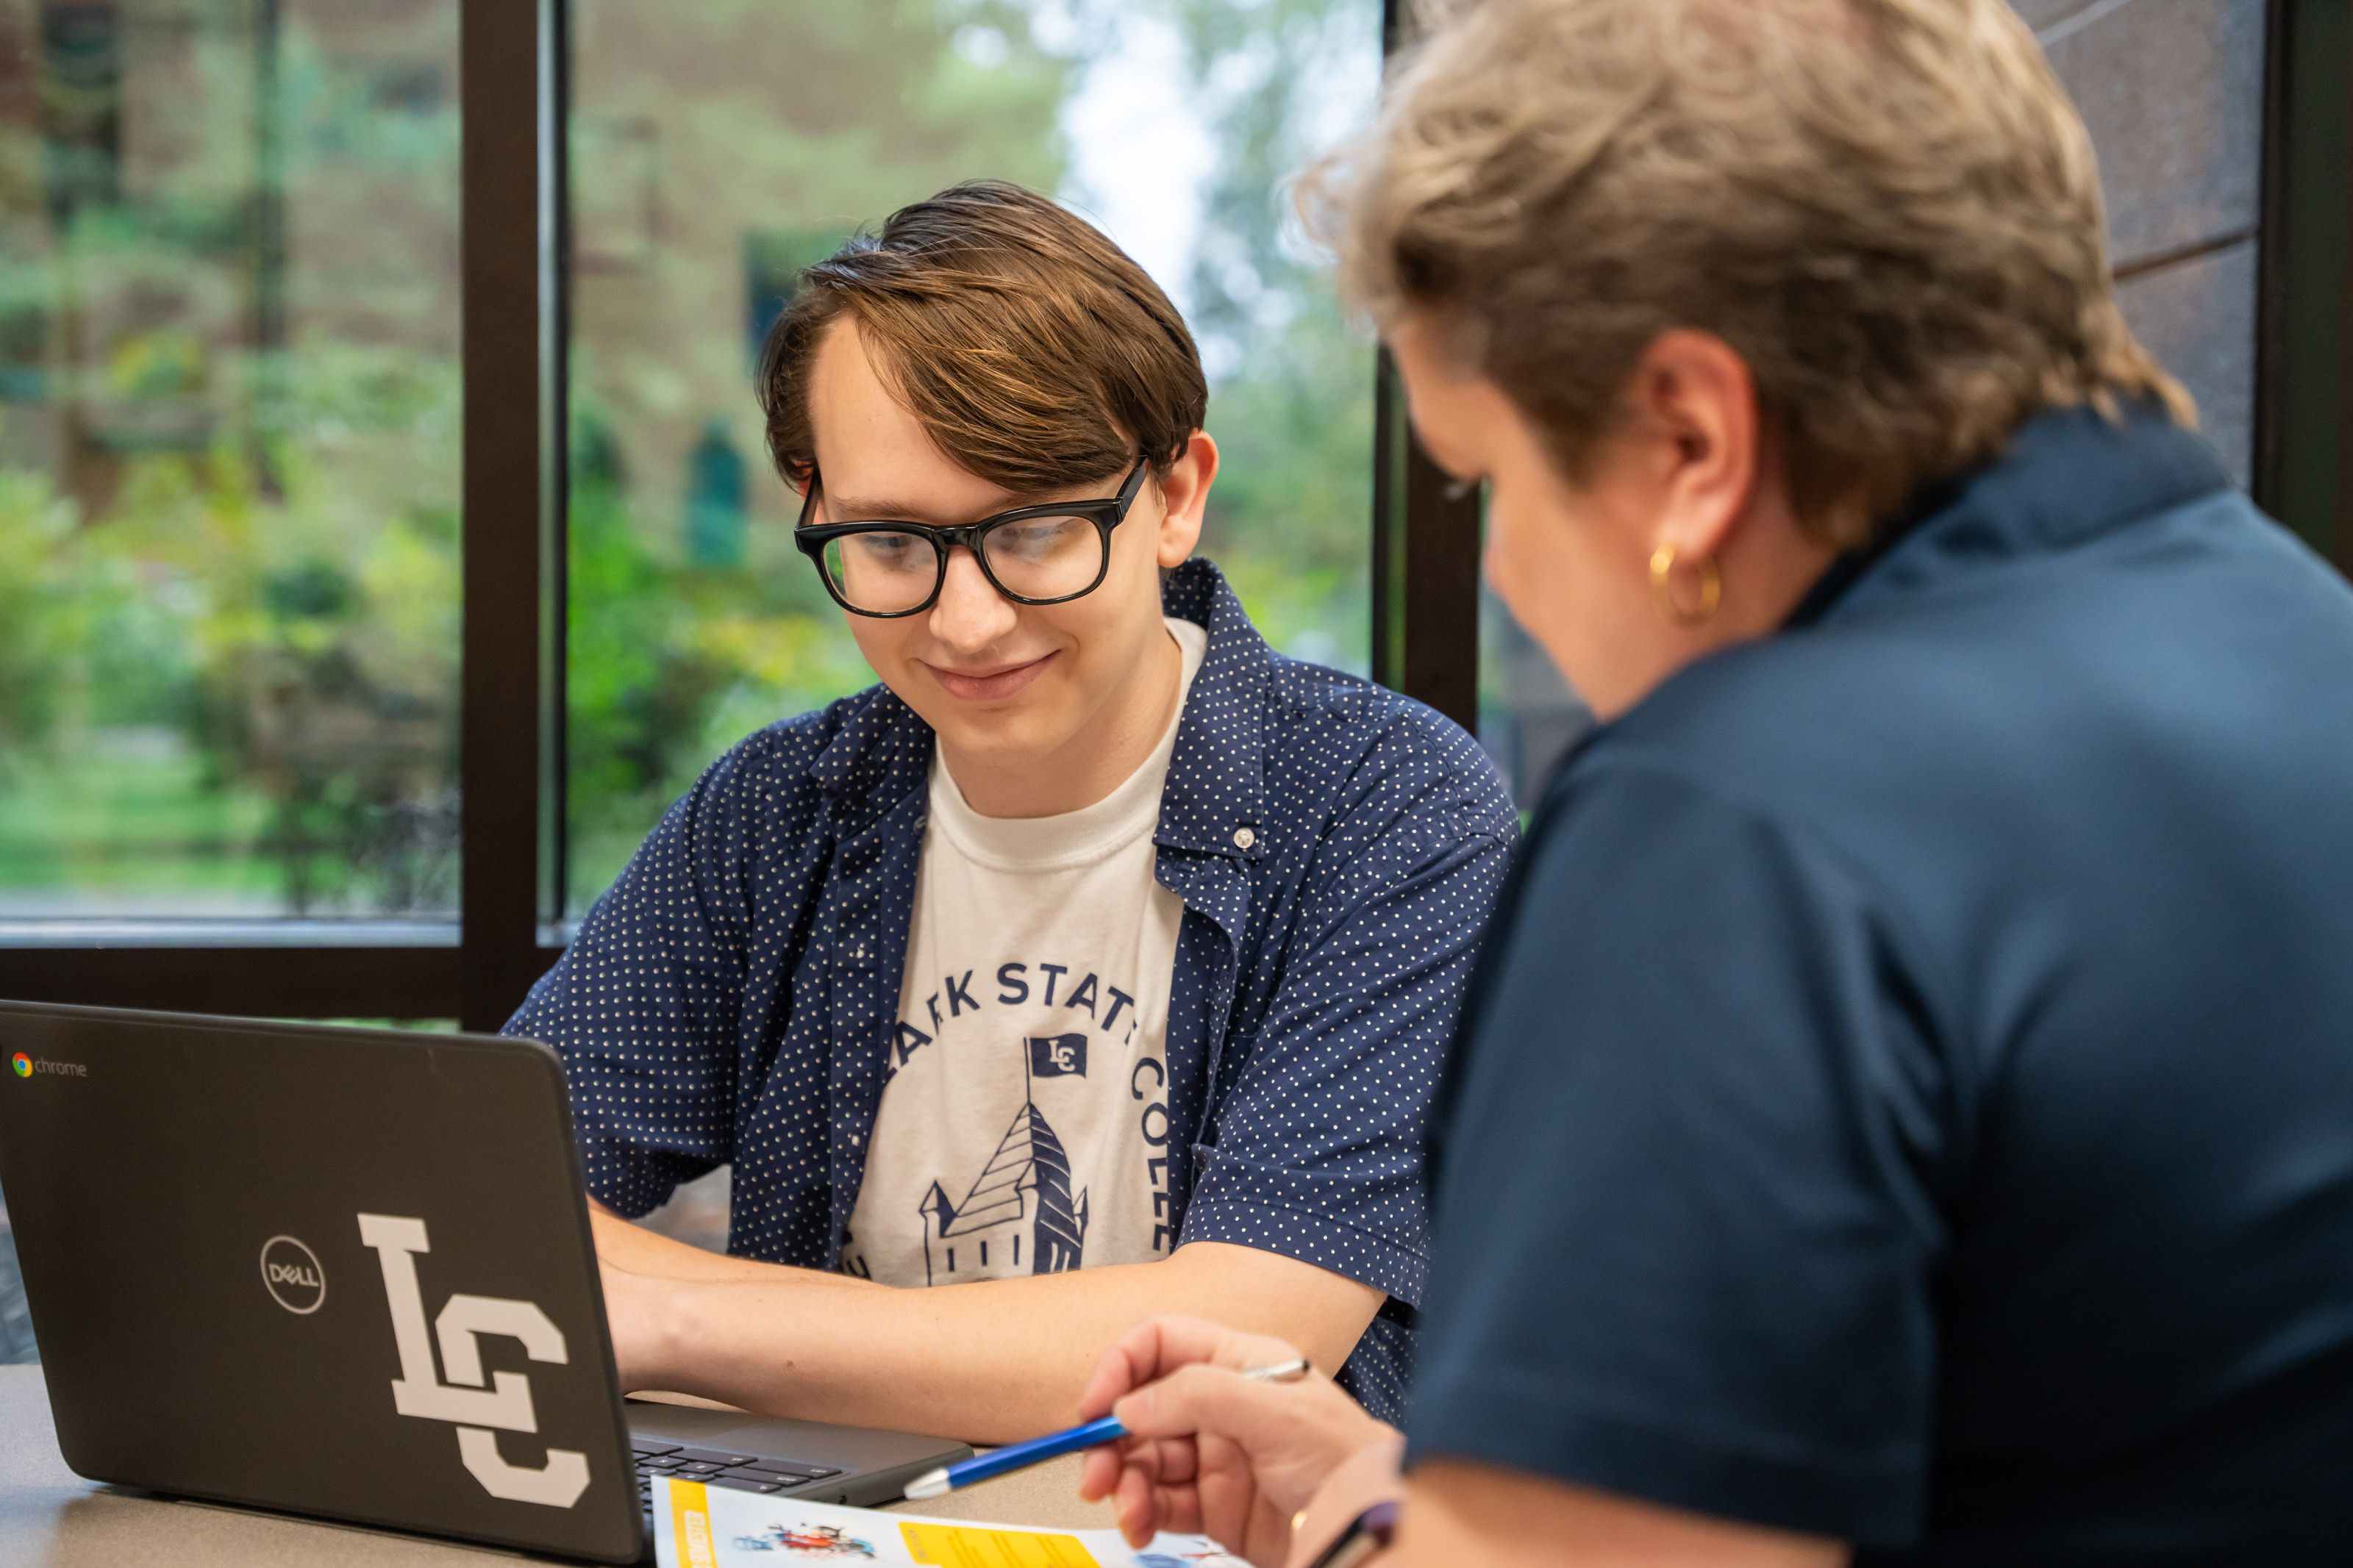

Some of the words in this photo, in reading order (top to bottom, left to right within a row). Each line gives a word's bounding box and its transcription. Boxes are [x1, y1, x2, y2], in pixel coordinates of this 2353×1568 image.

[996, 962, 1138, 1047] STAT
[34, 1058, 88, 1078] chrome
[1048, 1039, 1076, 1073] LC
[268, 1263, 320, 1287] DELL
[357, 1212, 591, 1509] LC
